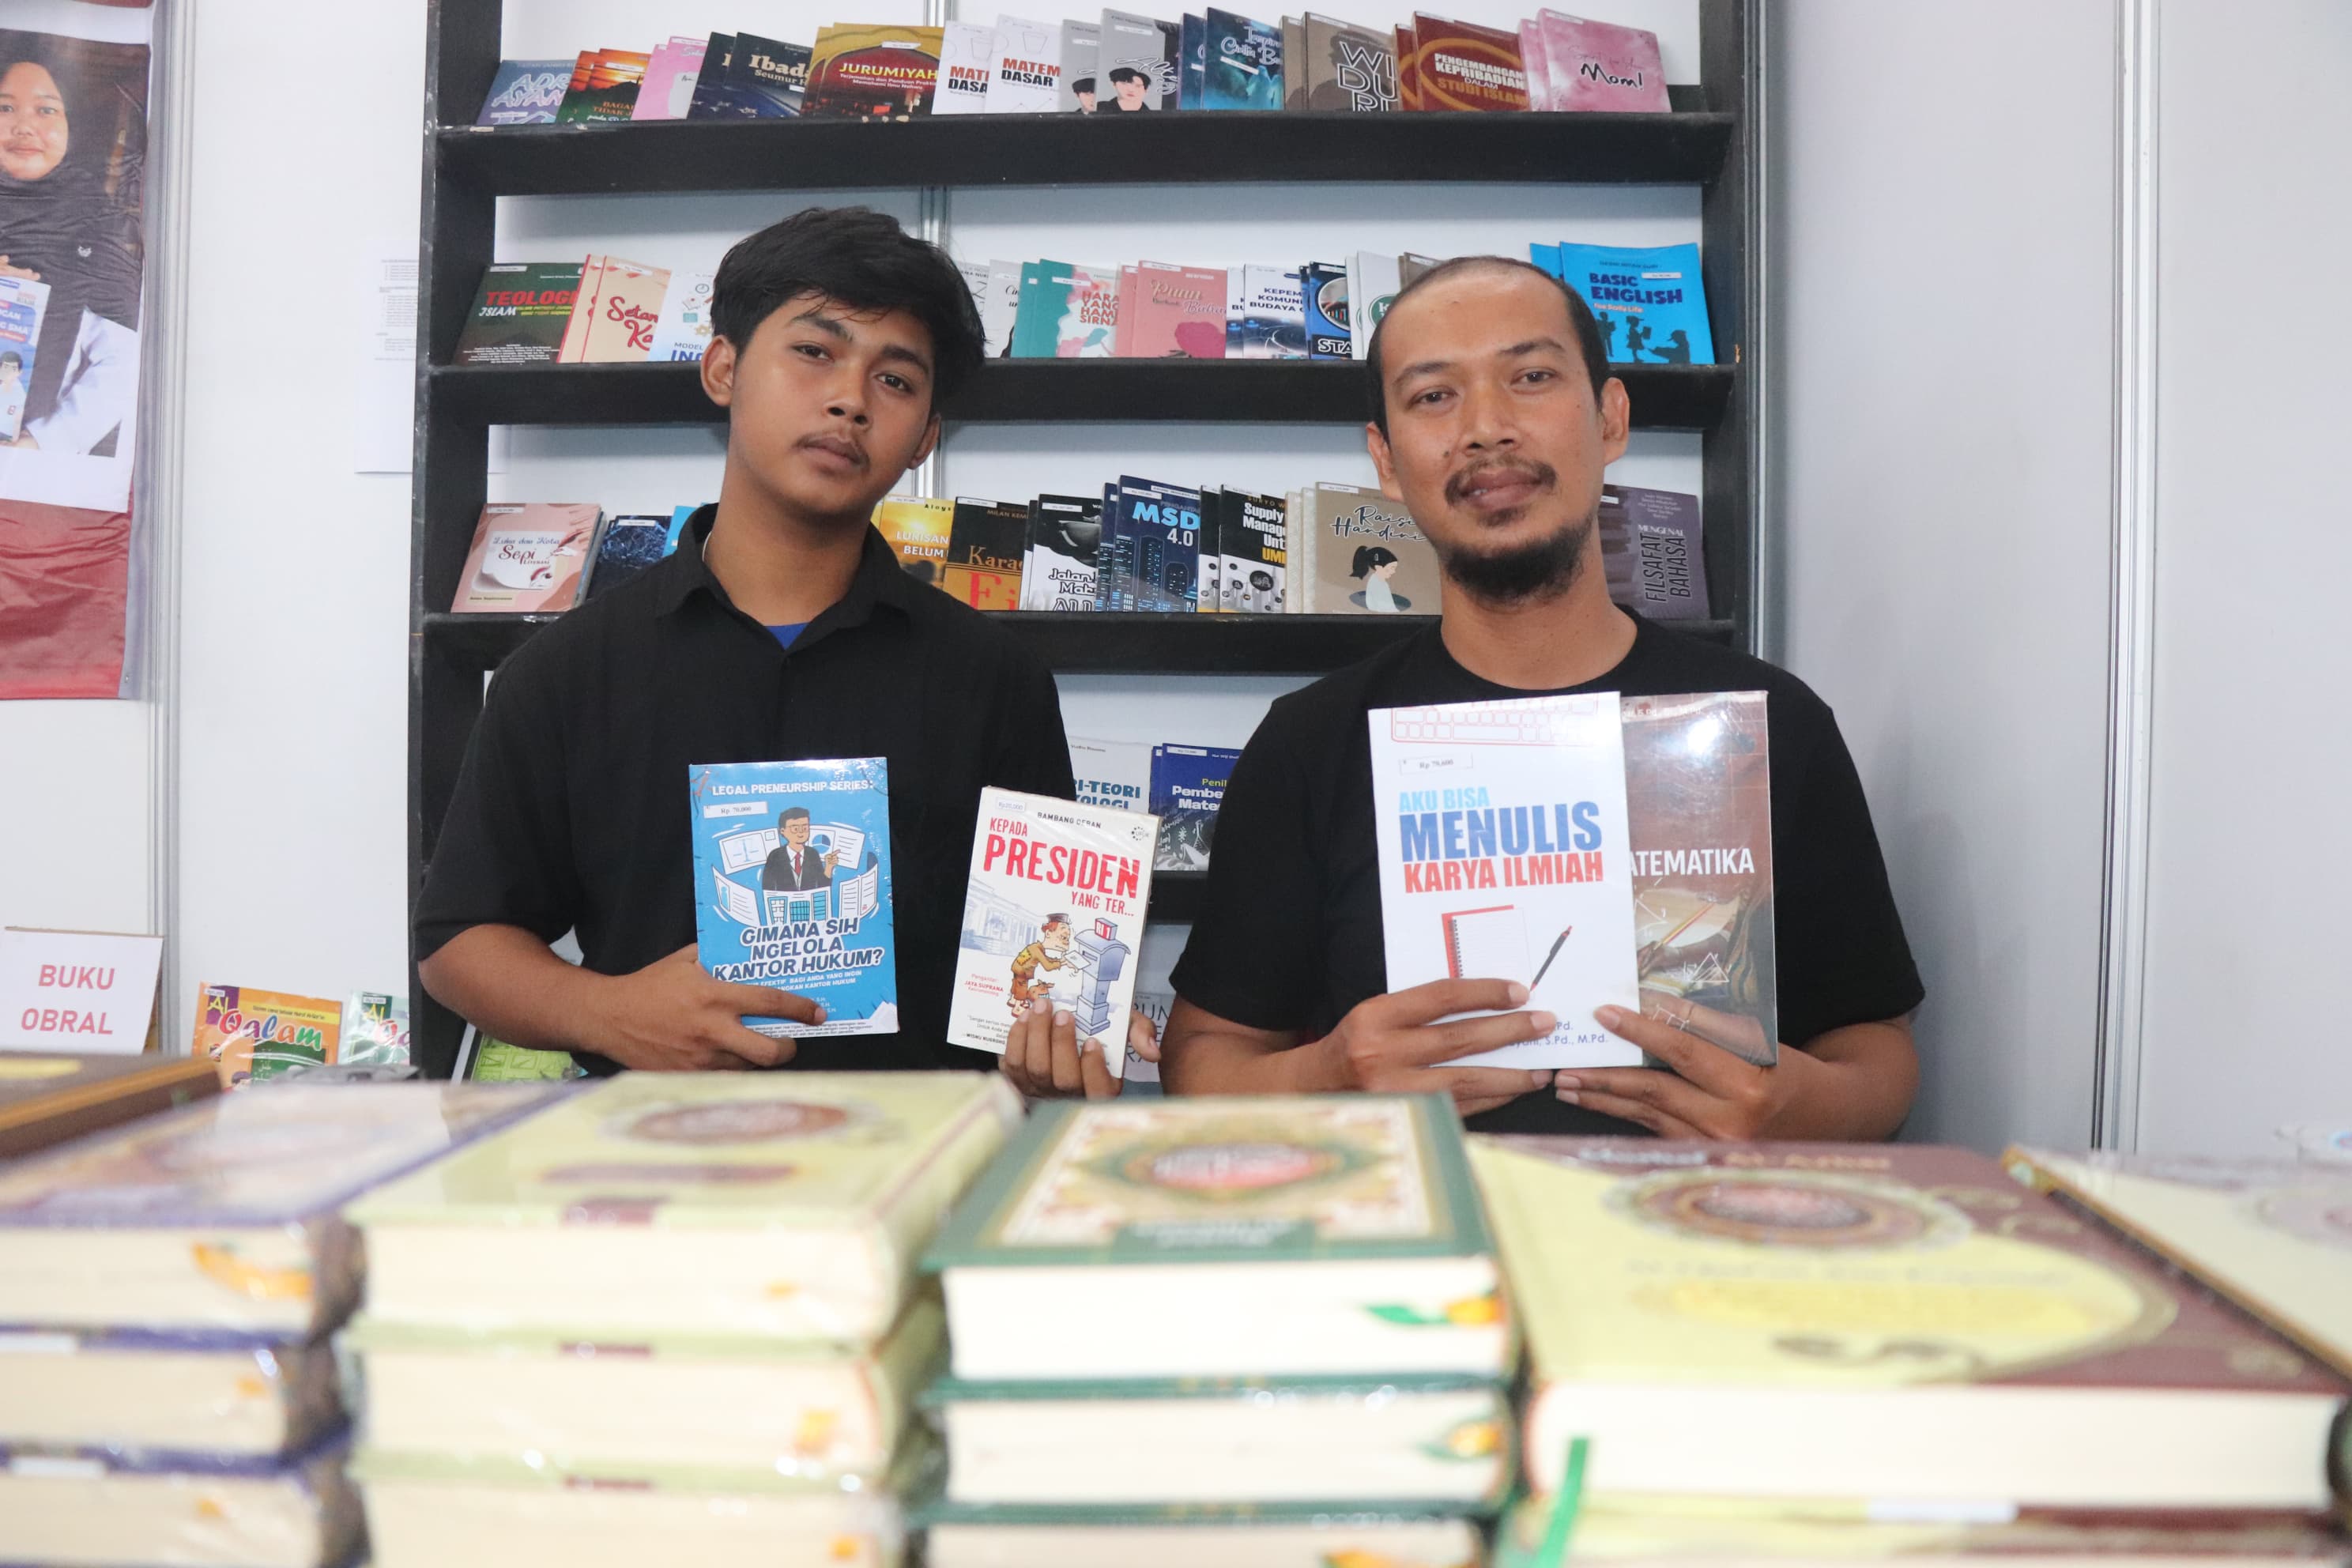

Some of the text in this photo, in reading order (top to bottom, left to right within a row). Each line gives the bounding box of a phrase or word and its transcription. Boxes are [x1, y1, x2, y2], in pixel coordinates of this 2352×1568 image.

[839, 62, 938, 80] JURUMIYAH
[1002, 58, 1061, 77] MATEM
[1434, 53, 1523, 78] PENGEMBANGAN
[1435, 62, 1525, 90] KEPRIBADIAN
[755, 70, 797, 85] Seumur
[1001, 70, 1054, 87] DASAR
[1437, 77, 1482, 96] STUDI
[1464, 77, 1498, 90] DALAM
[1581, 62, 1645, 91] Mom!
[1589, 273, 1638, 288] BASIC
[1590, 286, 1683, 305] ENGLISH
[1250, 301, 1296, 312] BUDAYA
[673, 341, 703, 350] MODEL
[1132, 501, 1201, 530] MSD
[1243, 502, 1284, 524] Supply
[1167, 527, 1194, 547] 4.0
[499, 544, 537, 566] Sepi
[903, 545, 944, 558] BELUM
[1048, 568, 1092, 583] Jalan
[1639, 533, 1668, 602] FILSAFAT
[1664, 537, 1691, 598] BAHASA
[712, 784, 749, 797] LEGAL
[751, 780, 827, 795] PRENEURSHIP
[1171, 785, 1223, 798] Pembe
[1398, 786, 1491, 813] AKU BISA
[989, 817, 1028, 837] KEPADA
[1036, 811, 1074, 824] BAMBANG
[1399, 801, 1603, 862] MENULIS
[983, 834, 1140, 899] PRESIDEN
[1403, 850, 1604, 894] KARYA ILMIAH
[1071, 891, 1135, 917] YANG TER...
[741, 917, 859, 946] GIMANA SIH
[1095, 920, 1105, 936] RI
[752, 936, 843, 961] NGELOLA
[713, 948, 884, 981] KANTOR HUKUM?
[38, 964, 115, 990] BUKU
[21, 1008, 114, 1035] OBRAL
[218, 1008, 322, 1052] Qalam
[1577, 1033, 1608, 1044] M.Pd.
